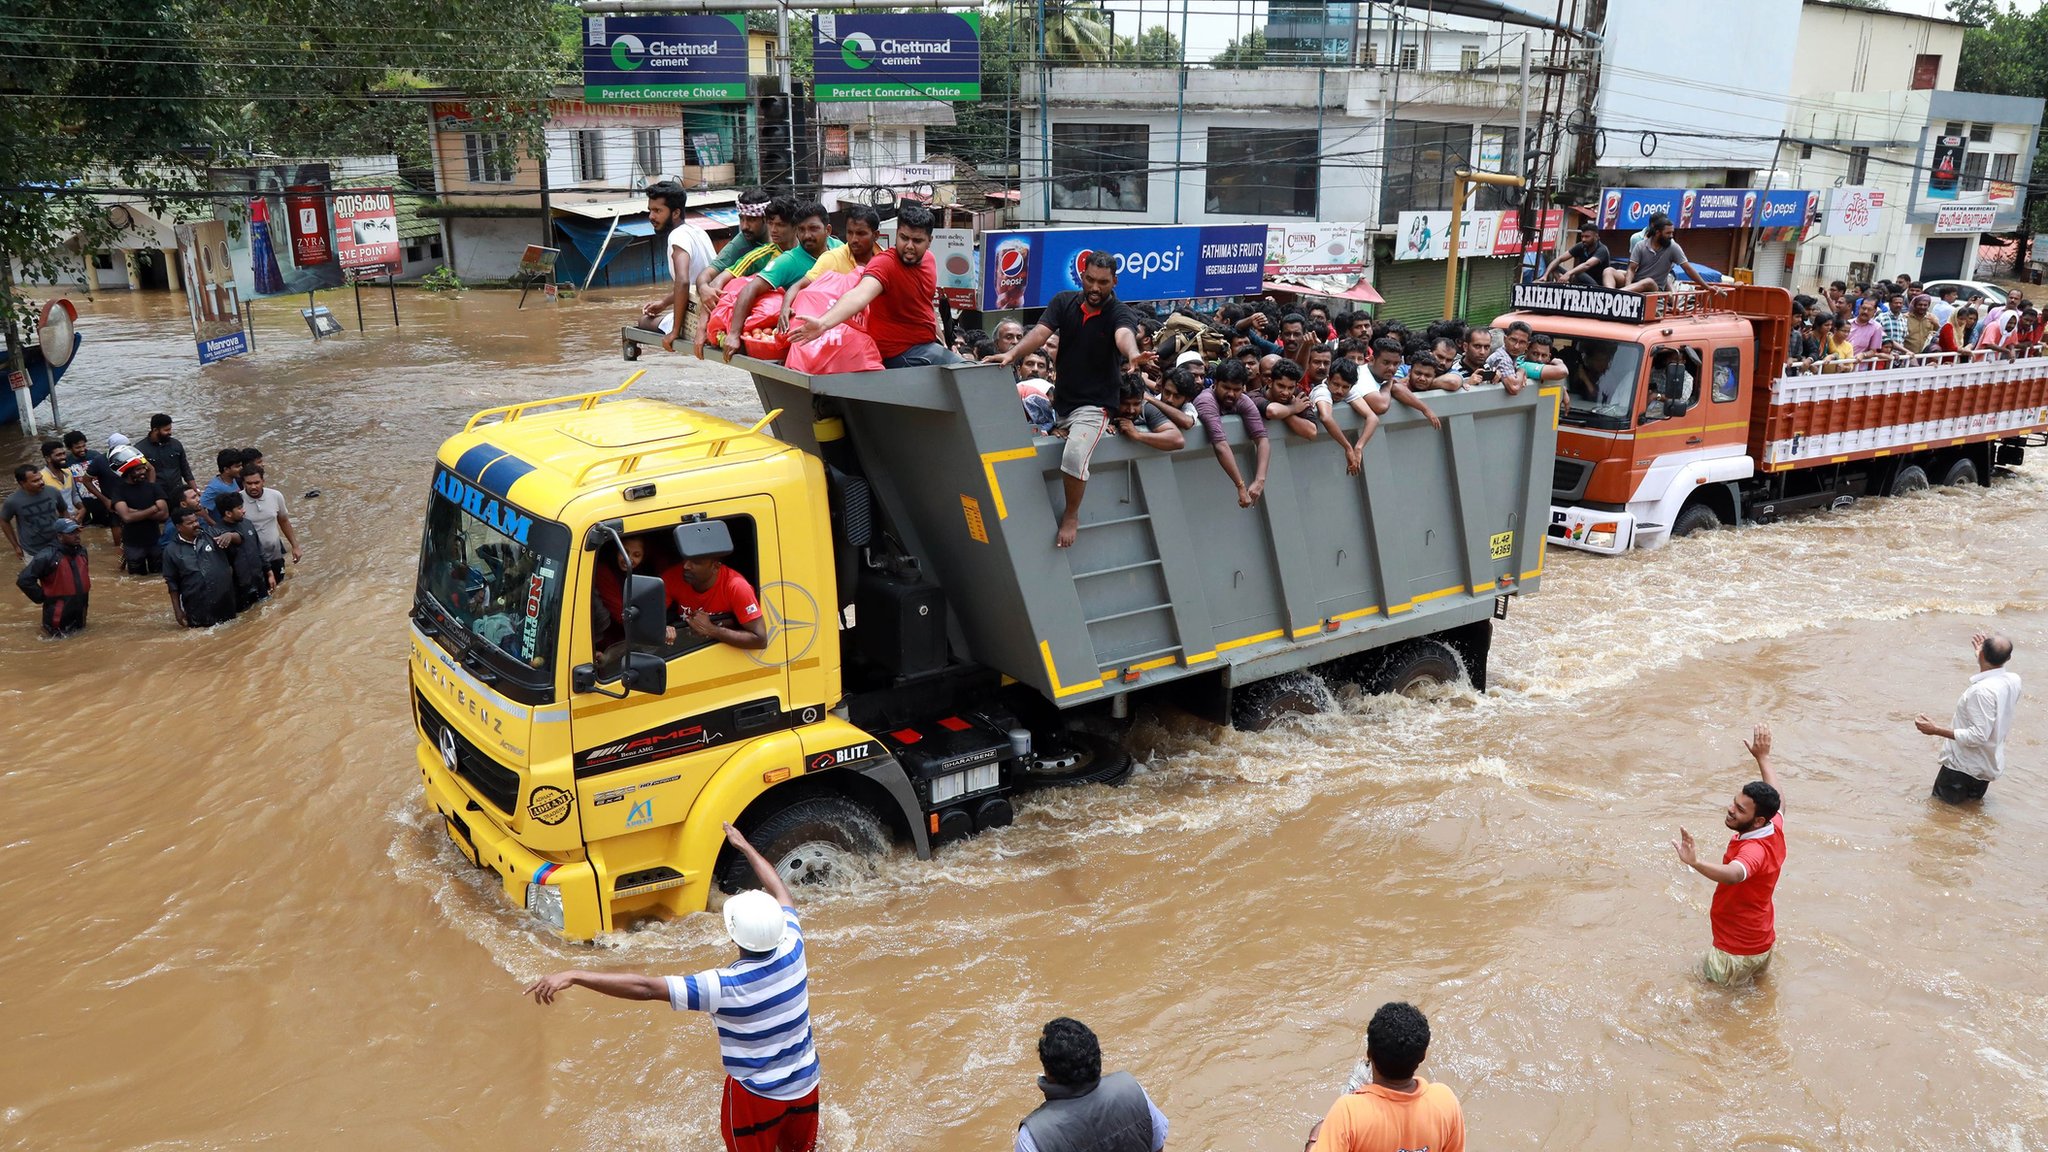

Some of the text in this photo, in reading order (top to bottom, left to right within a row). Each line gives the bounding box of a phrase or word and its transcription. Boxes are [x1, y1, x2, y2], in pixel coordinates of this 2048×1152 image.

[650, 40, 717, 56] Chettinad
[881, 39, 950, 54] Chettinad
[650, 57, 688, 67] cement
[882, 55, 921, 66] cement
[602, 87, 728, 99] Perfect Concrete Choice
[832, 86, 961, 97] Perfect Concrete Choice
[582, 103, 620, 116] TOURS
[637, 103, 681, 118] TRAVELS
[905, 167, 933, 176] HOTEL
[1772, 201, 1797, 217] pepsi
[1853, 193, 1867, 209] Tea
[1699, 210, 1715, 219] BAKERY
[1718, 210, 1736, 219] COOLBAR
[1844, 203, 1868, 231] Spot
[297, 236, 325, 248] ZYRA
[1287, 234, 1316, 248] CHINNAR
[339, 249, 356, 261] EYE
[360, 245, 387, 258] POINT
[1202, 243, 1263, 259] FATHIMA'S FRUITS
[1205, 263, 1233, 275] VEGETABLES
[1237, 263, 1257, 274] COOLBAR
[1001, 277, 1023, 287] pepsi
[1515, 285, 1642, 319] RAIHAN TRANSPORT
[206, 337, 239, 353] Manrova
[433, 470, 533, 545] ADHAM
[526, 573, 545, 619] NO
[410, 641, 503, 736] BHARATBENZ
[627, 725, 702, 750] AMG
[620, 750, 638, 758] Benz
[637, 745, 654, 754] AMG
[836, 744, 869, 763] BLITZ
[944, 750, 995, 769] BHARATBENZ
[531, 793, 569, 816] ADHAM
